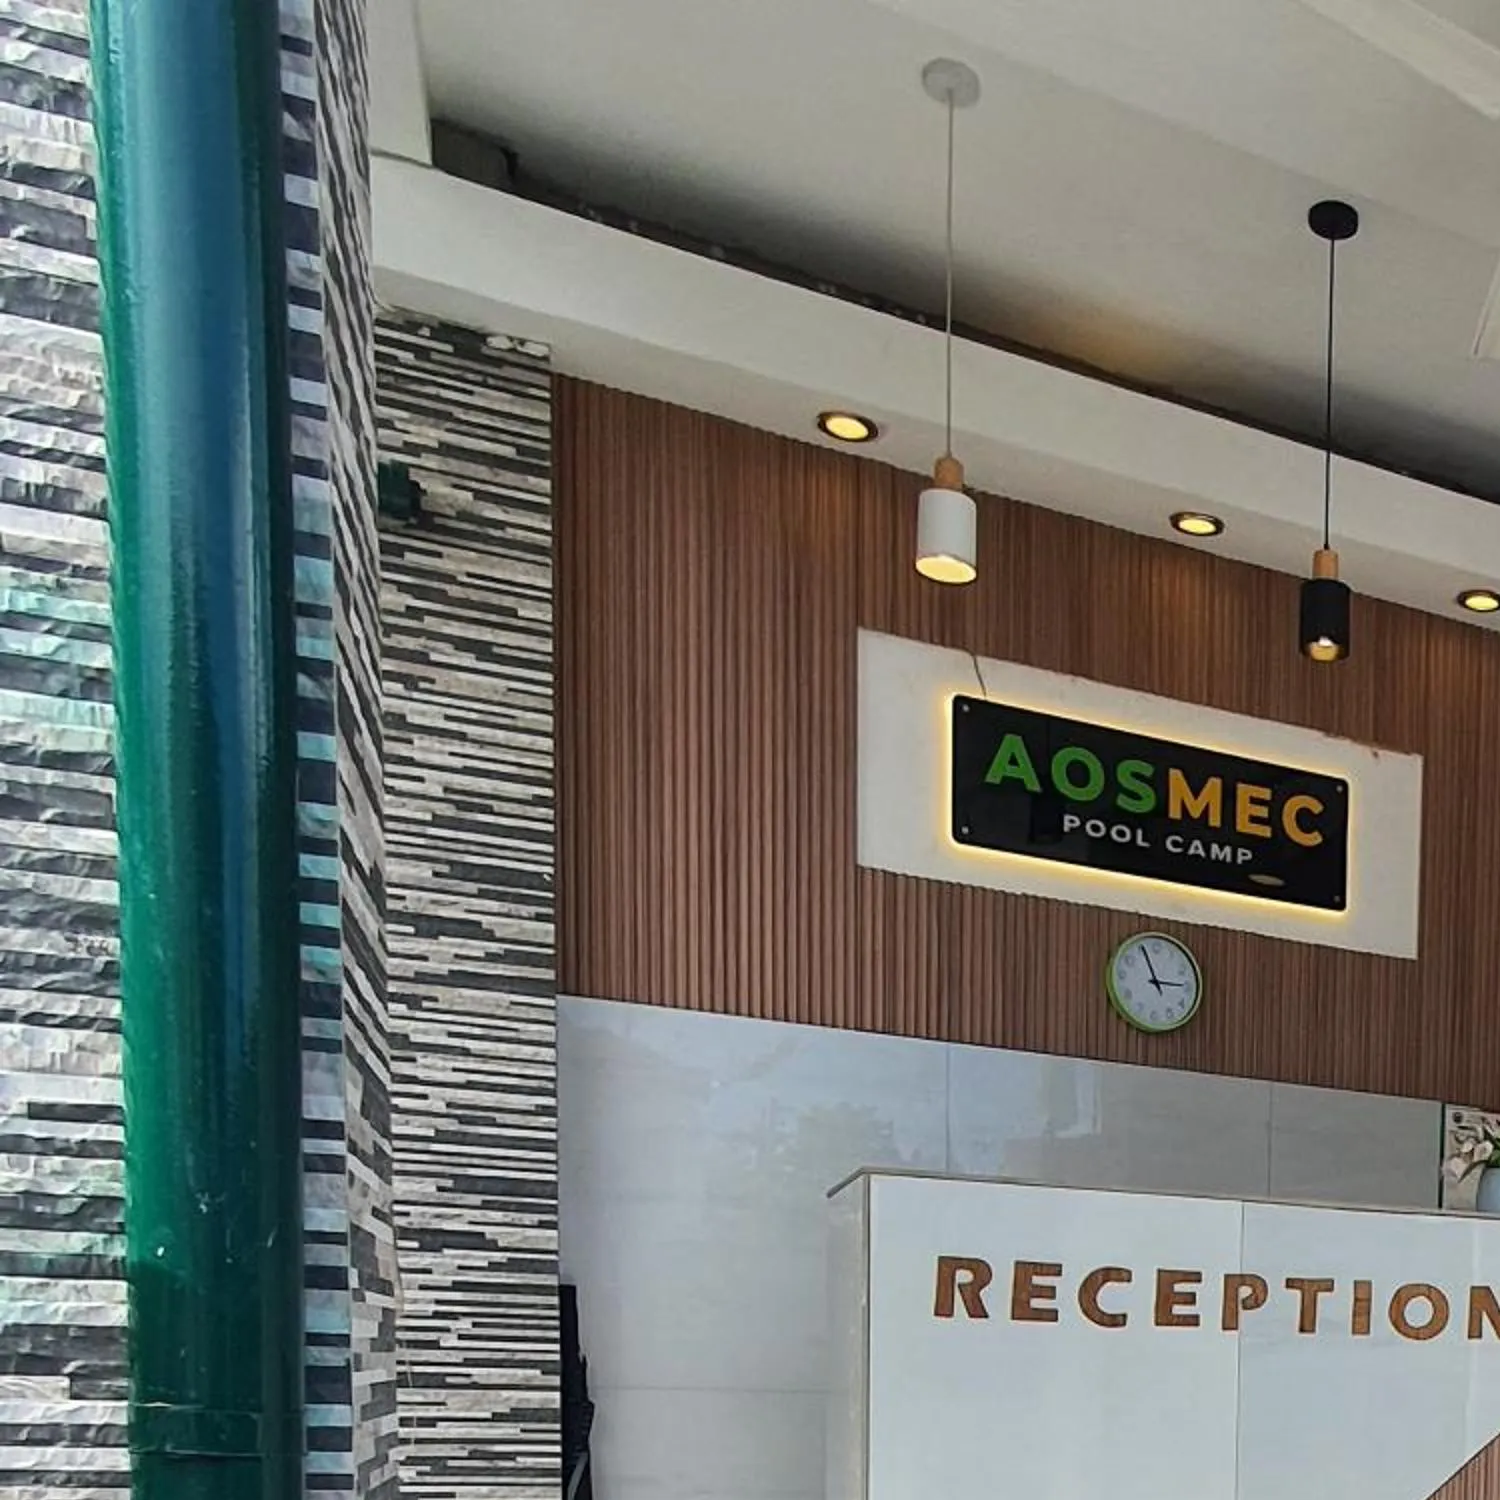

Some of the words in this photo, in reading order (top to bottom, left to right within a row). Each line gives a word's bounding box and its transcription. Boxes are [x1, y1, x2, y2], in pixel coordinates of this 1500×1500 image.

[984, 733, 1326, 847] AOSMEC
[1062, 814, 1151, 847] POOL
[1165, 835, 1253, 865] CAMP
